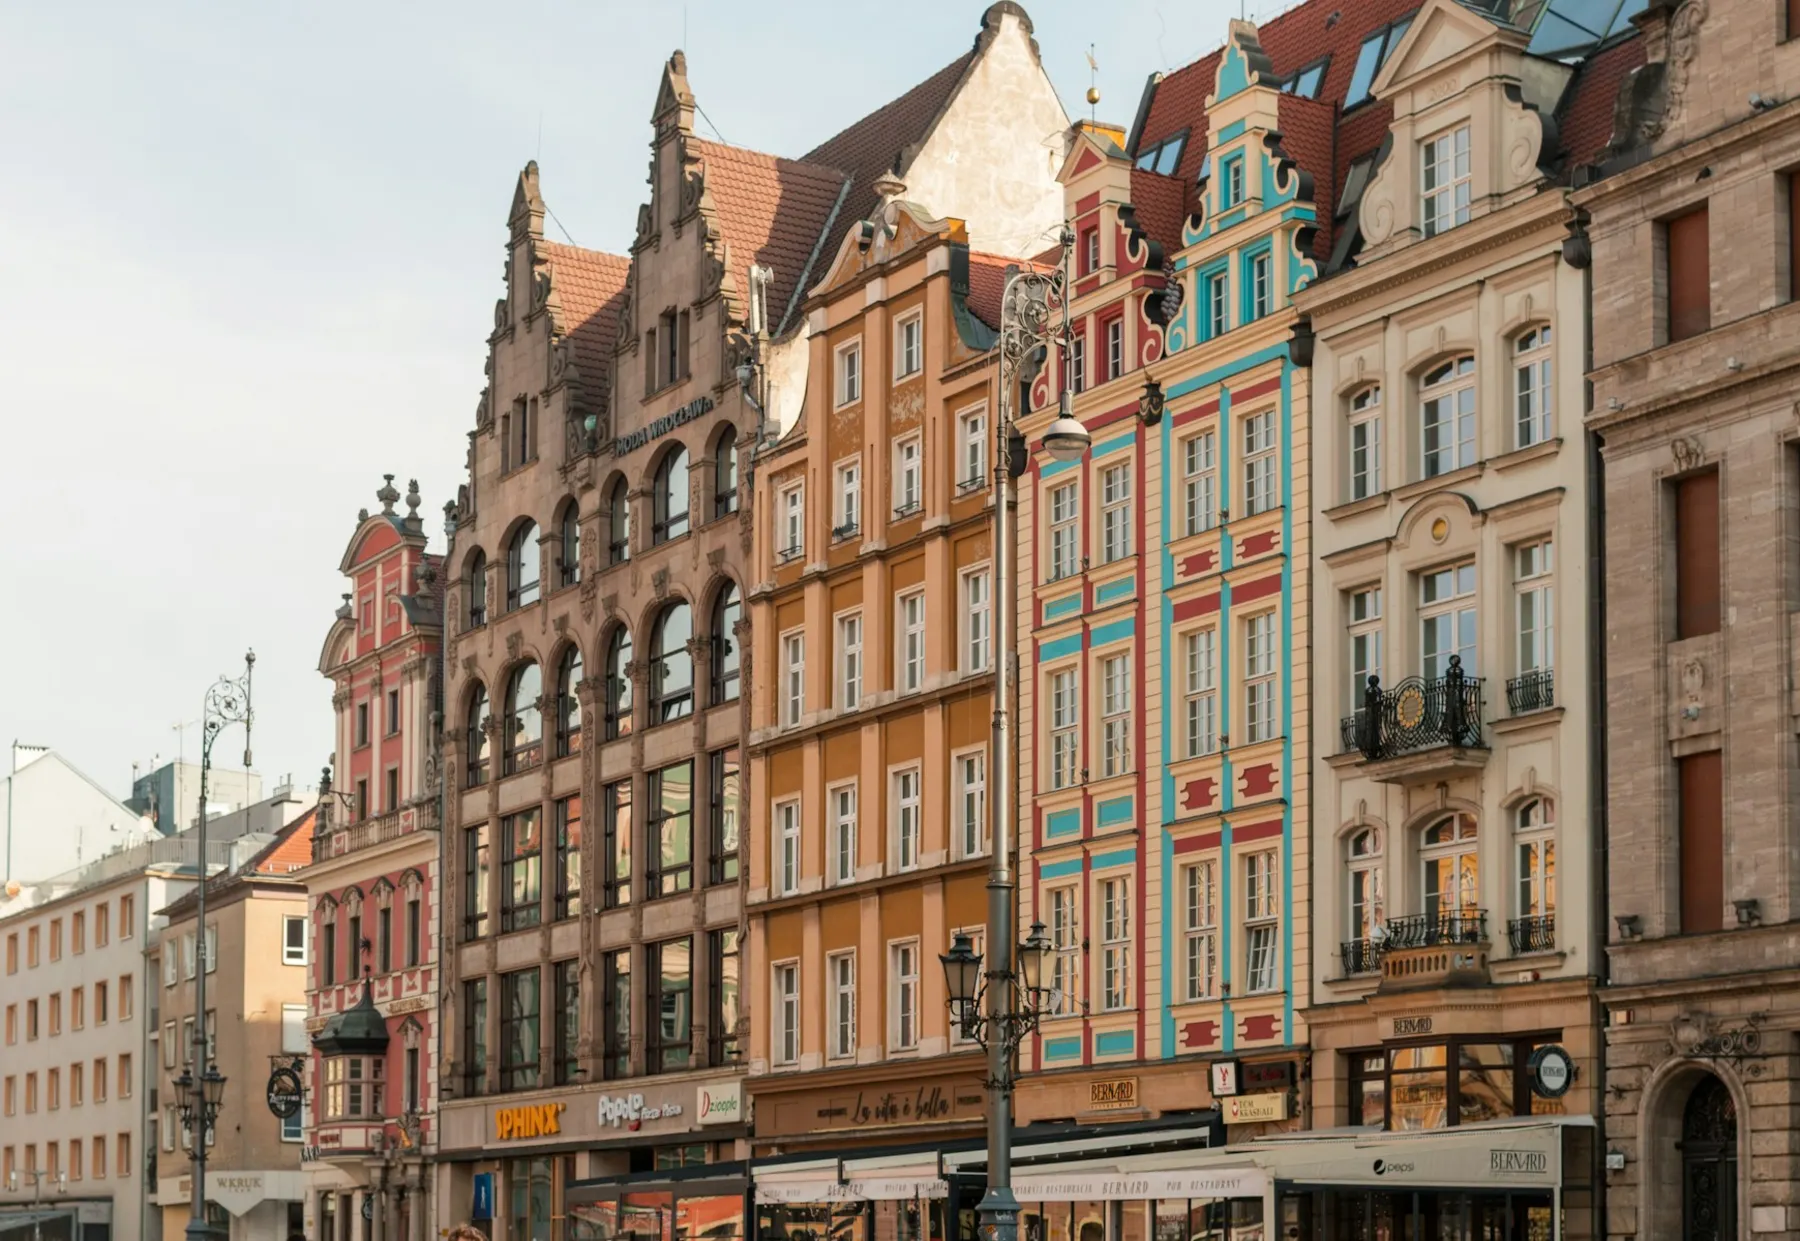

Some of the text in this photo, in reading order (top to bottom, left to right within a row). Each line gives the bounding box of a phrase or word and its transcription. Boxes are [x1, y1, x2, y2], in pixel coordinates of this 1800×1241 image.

[616, 427, 650, 457] MODA
[1393, 1018, 1432, 1034] BERNARD
[1091, 1081, 1133, 1101] BERNARD
[495, 1103, 560, 1140] SPHINX
[1387, 1162, 1414, 1174] pepsi
[1491, 1152, 1546, 1171] BERNARD
[1102, 1181, 1149, 1195] BERNARD
